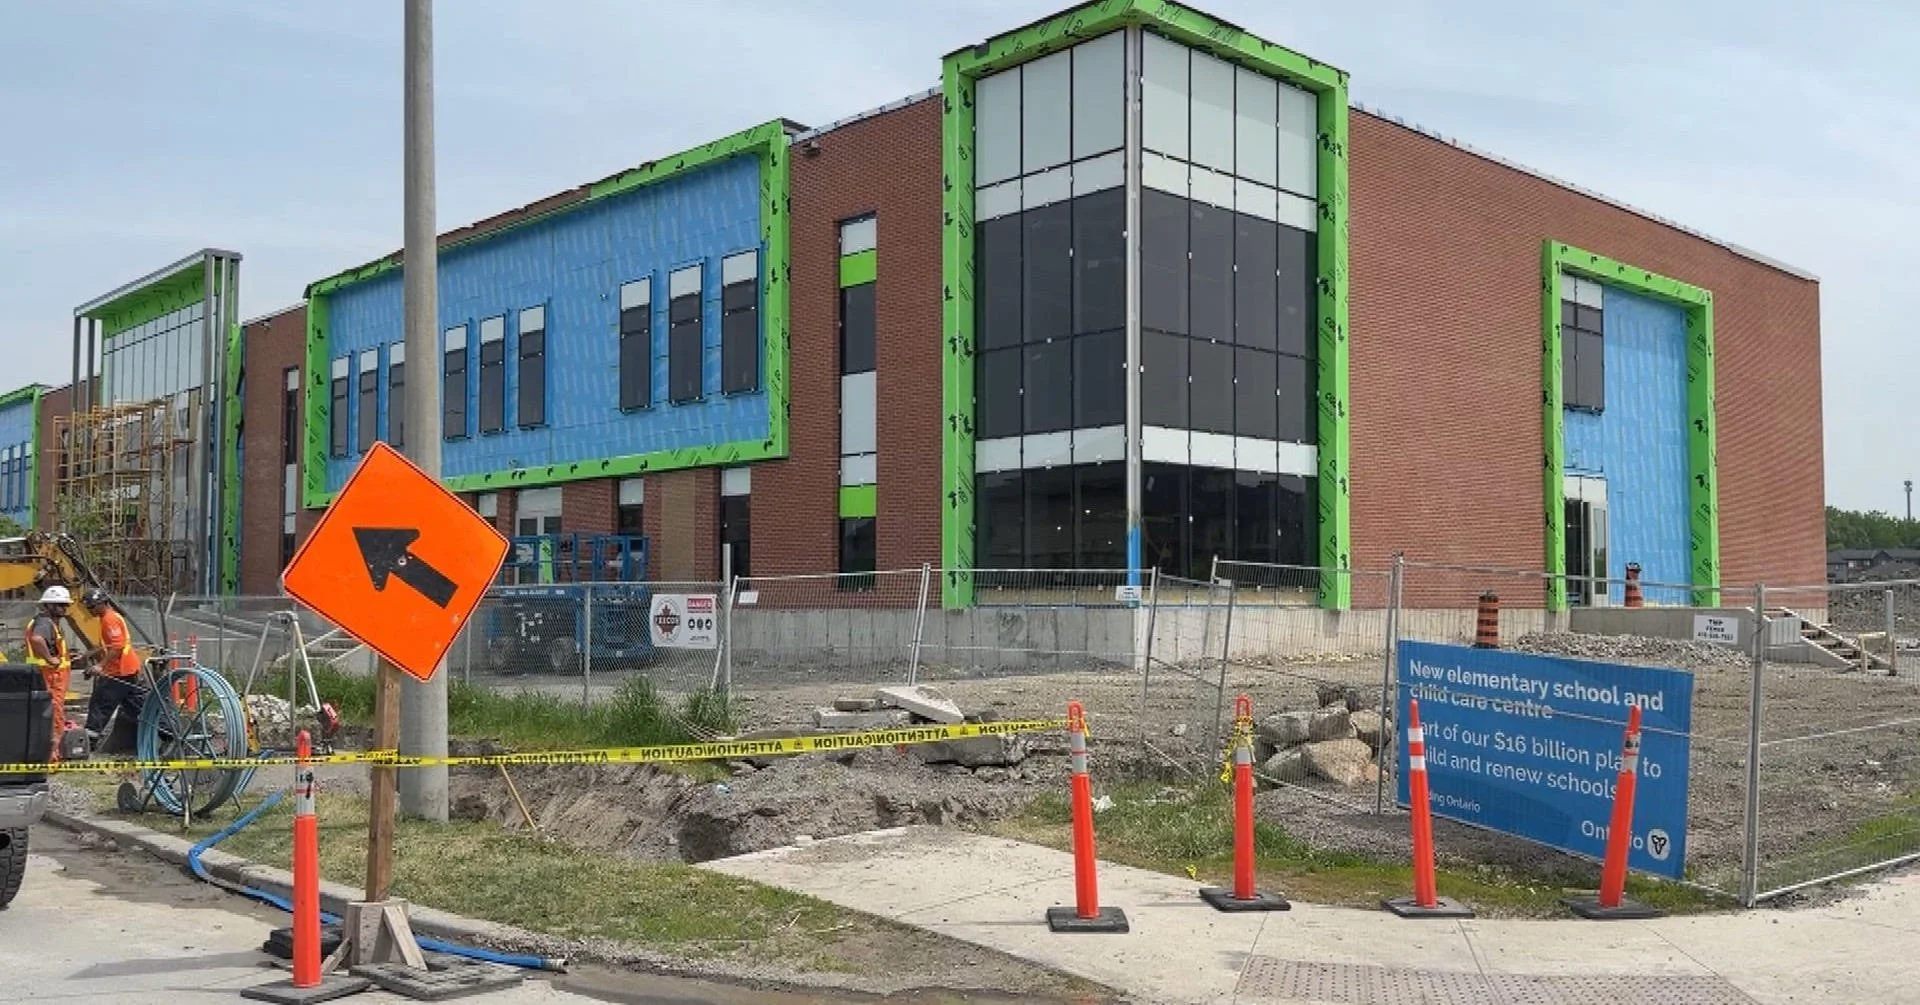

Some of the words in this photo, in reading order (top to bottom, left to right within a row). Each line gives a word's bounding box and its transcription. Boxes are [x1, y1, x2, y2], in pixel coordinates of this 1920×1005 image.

[1409, 659, 1444, 680] New
[1447, 665, 1549, 700] elementary
[1553, 680, 1620, 706] school
[1623, 690, 1664, 712] and
[1410, 682, 1448, 704] child
[1451, 692, 1488, 711] care
[1492, 698, 1553, 719] centre
[1418, 721, 1439, 738] art
[1443, 724, 1459, 742] of
[1462, 729, 1490, 748] our
[1494, 731, 1527, 754] $16
[1532, 736, 1590, 765] billion
[1595, 748, 1624, 772] pla
[1642, 756, 1662, 778] to
[1424, 744, 1447, 766] ild
[1450, 755, 1481, 773] and
[1486, 761, 1543, 784] renew
[1547, 771, 1618, 801] schools
[1446, 794, 1481, 813] Ontario
[1581, 820, 1644, 849] Ontio
